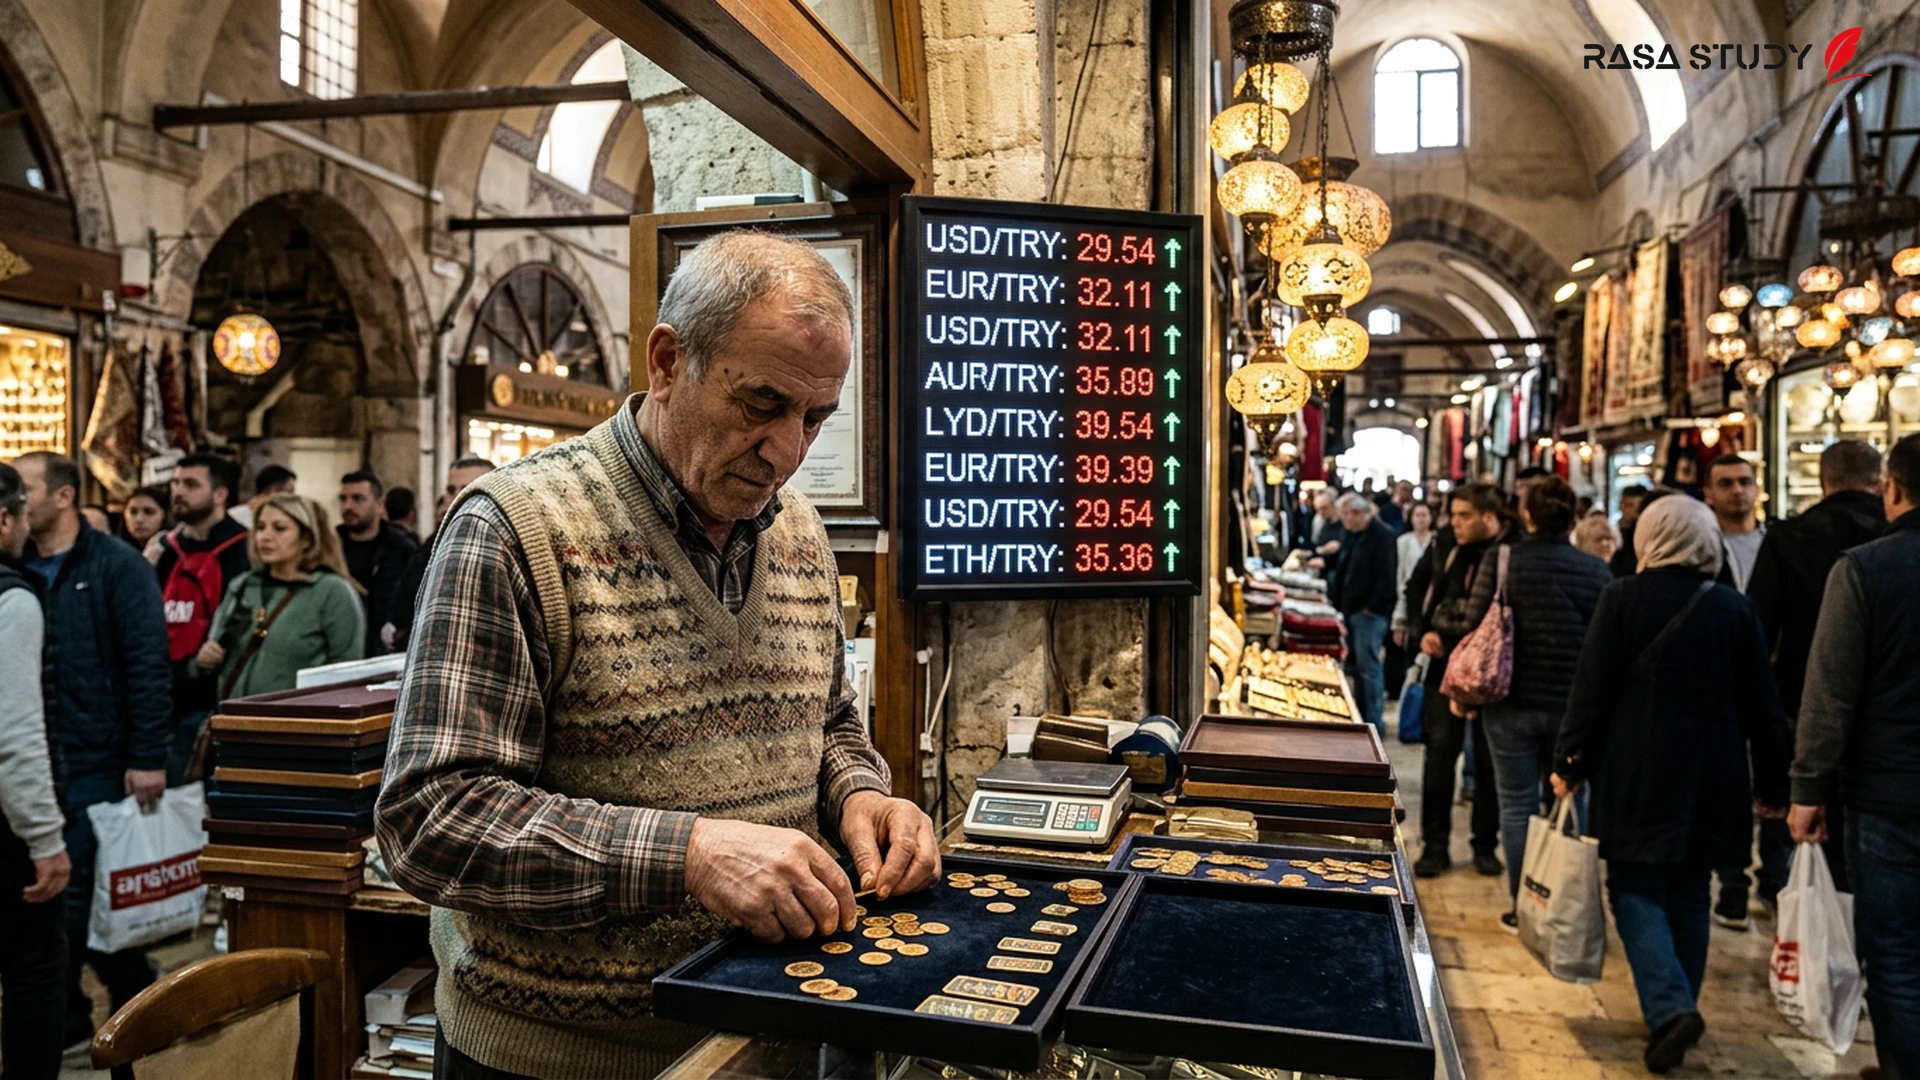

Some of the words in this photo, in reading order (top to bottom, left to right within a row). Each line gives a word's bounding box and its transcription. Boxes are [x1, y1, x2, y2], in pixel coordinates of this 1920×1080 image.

[926, 223, 1067, 259] USD/TRY:
[1077, 233, 1156, 265] 29.54
[926, 269, 1065, 304] EUR/TRY:
[1077, 277, 1152, 309] 32.11
[926, 315, 1067, 349] USD/TRY:
[1077, 322, 1152, 353] 32.11
[925, 362, 1065, 393] AUR/TRY:
[1075, 366, 1154, 397] 35.89
[925, 407, 1064, 438] LYD/TRY:
[1075, 410, 1154, 440] 39.54
[925, 453, 1064, 483] EUR/TRY:
[1075, 455, 1154, 484] 39.39
[925, 499, 1065, 528] USD/TRY:
[1075, 499, 1154, 528] 29.54
[925, 544, 1064, 573] ETH/TRY:
[1075, 543, 1154, 572] 35.36
